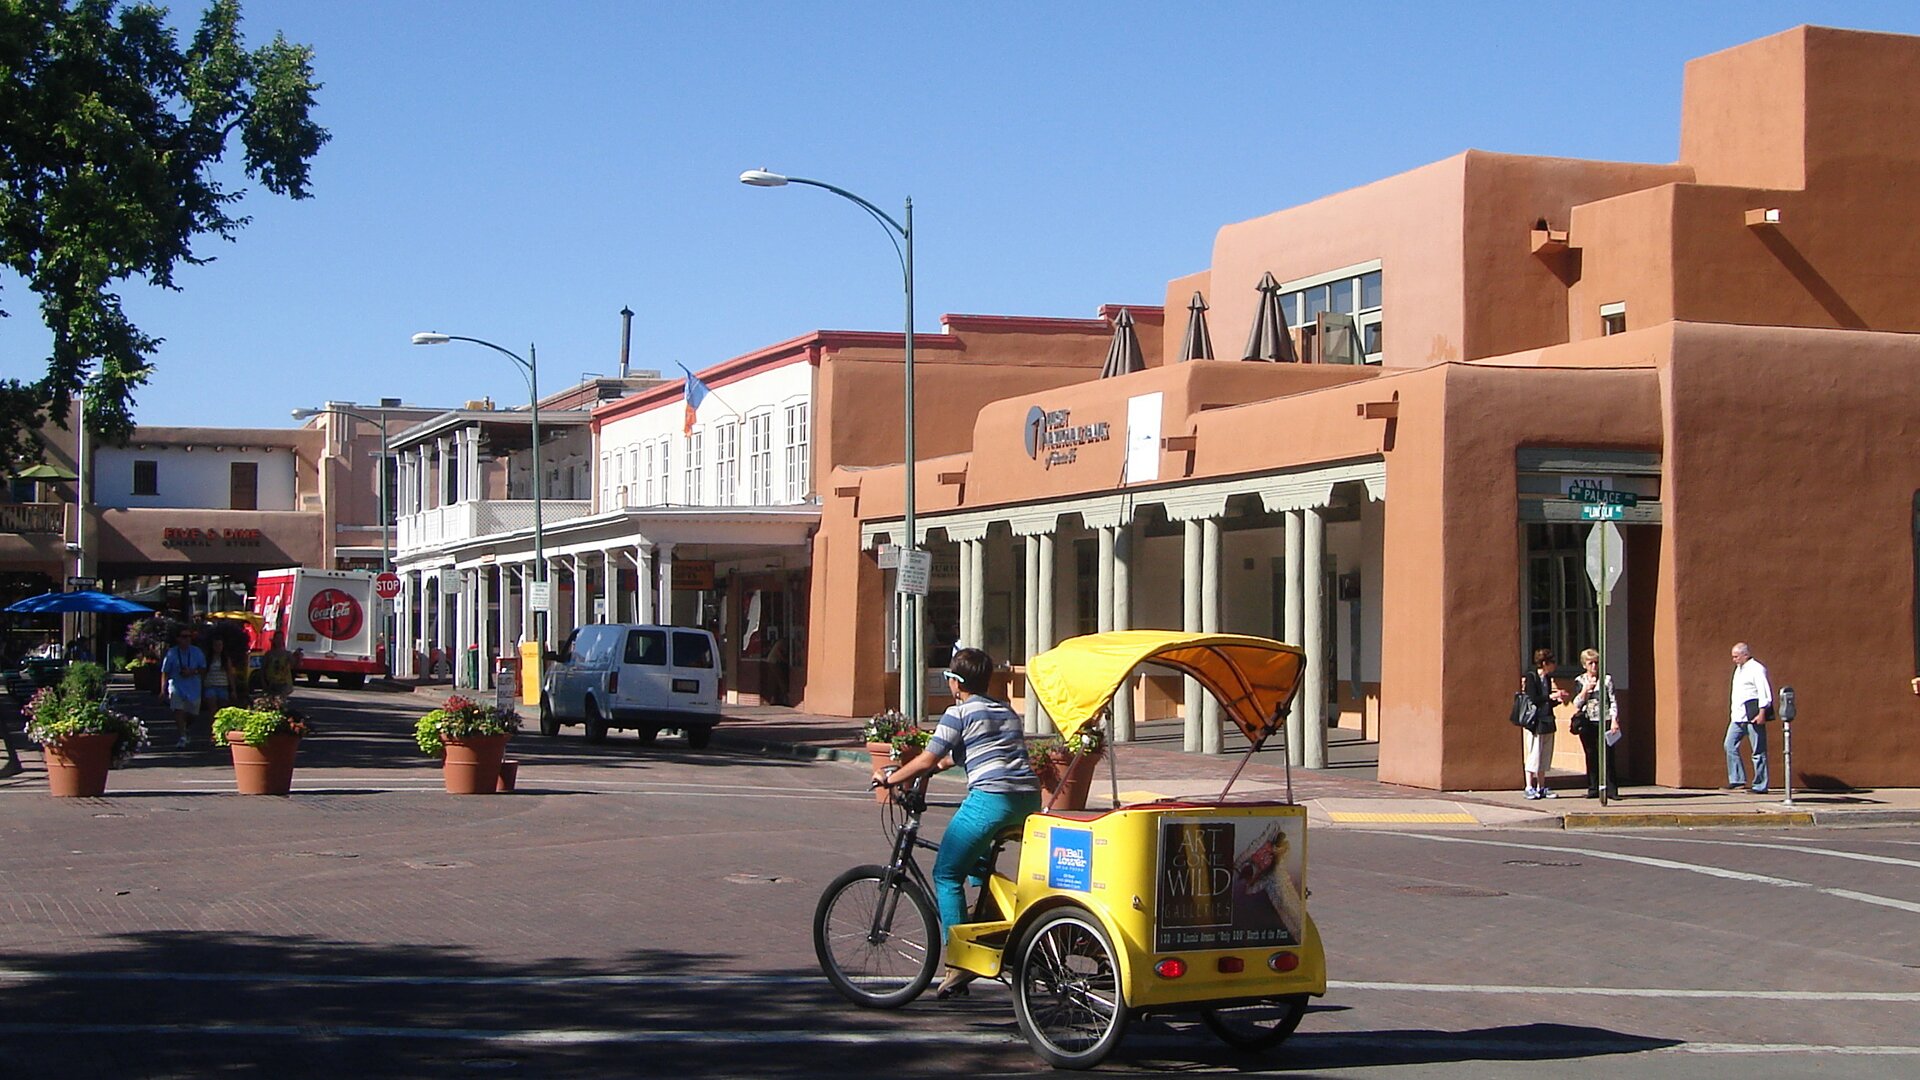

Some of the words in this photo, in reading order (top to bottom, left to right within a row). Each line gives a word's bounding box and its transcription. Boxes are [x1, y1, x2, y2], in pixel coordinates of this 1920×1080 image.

[1571, 480, 1602, 490] ATM
[1584, 490, 1620, 503] PALACE
[164, 528, 199, 539] FIVE
[223, 528, 260, 539] DIME
[376, 580, 399, 591] STOP
[310, 601, 350, 622] Coca-Cola
[1177, 829, 1223, 853] ART
[1066, 849, 1084, 859] Bell
[1173, 853, 1225, 867] GONE
[1167, 868, 1231, 897] WILD
[1165, 903, 1230, 918] GALLERIES
